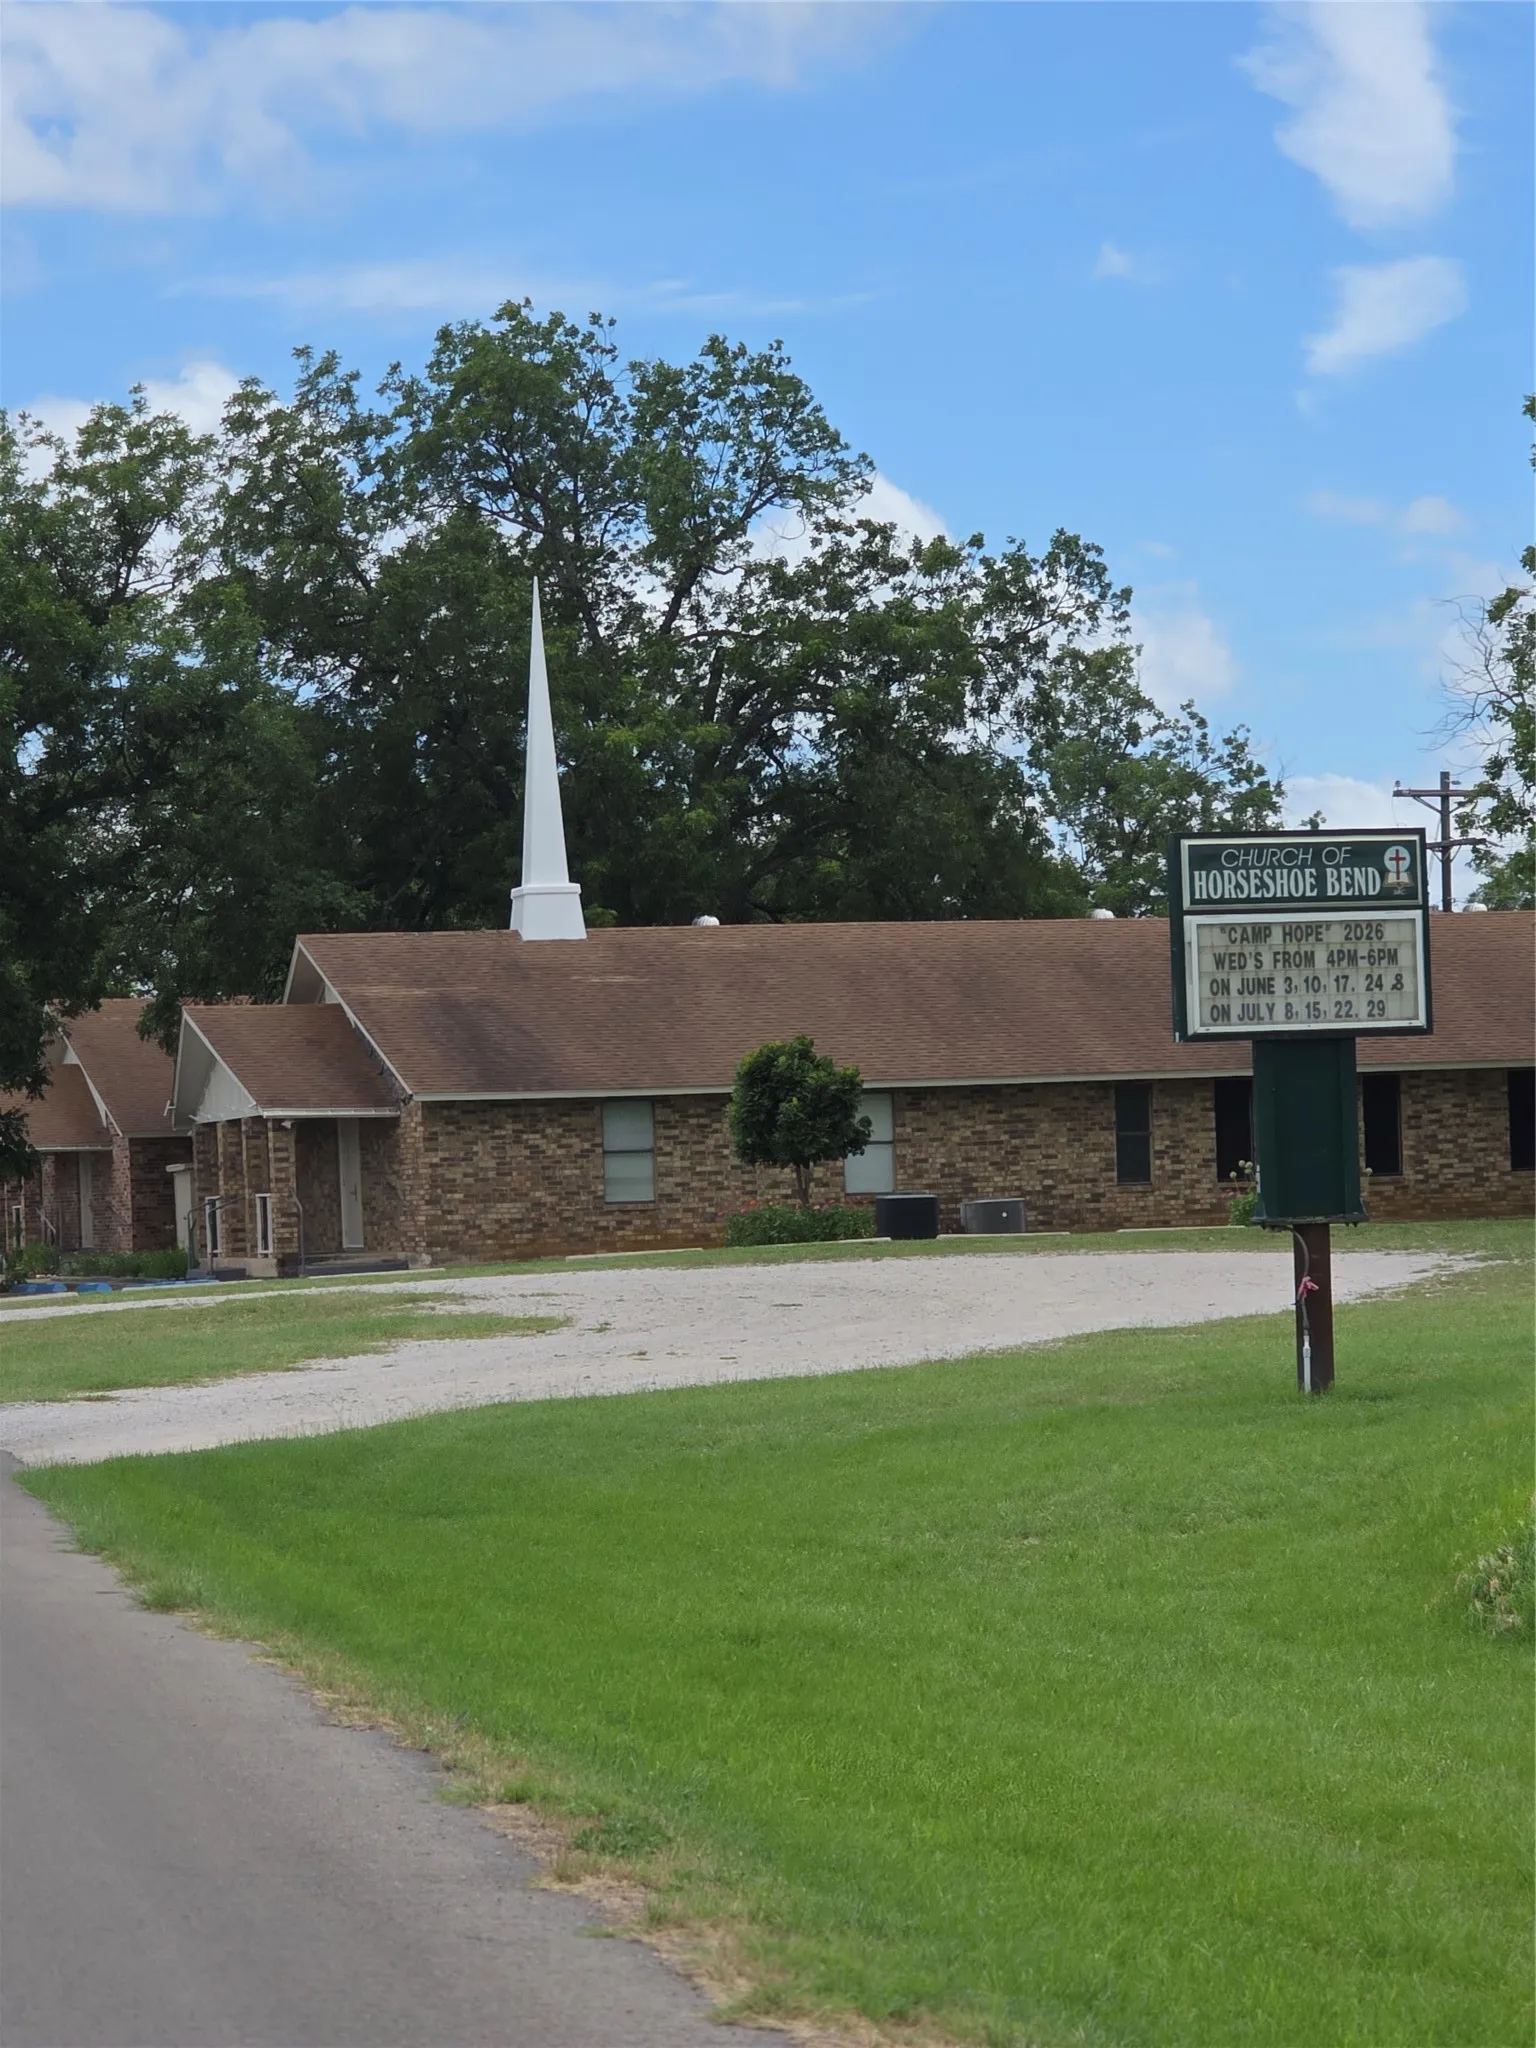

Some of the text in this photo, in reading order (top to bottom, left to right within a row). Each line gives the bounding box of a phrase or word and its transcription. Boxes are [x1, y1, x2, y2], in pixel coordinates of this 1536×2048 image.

[1221, 846, 1352, 867] CHURCH OF
[1193, 866, 1382, 900] HORSESHOE BEND
[1219, 922, 1385, 945] "CAMP HOPE" 2026
[1213, 947, 1399, 971] WED'S FROM 4PM-6PM
[1209, 977, 1231, 997] ON
[1237, 976, 1276, 996] JUNE
[1365, 973, 1384, 992] 24
[1210, 1003, 1232, 1023] ON
[1237, 1002, 1276, 1022] JULY
[1366, 998, 1386, 1018] 29
